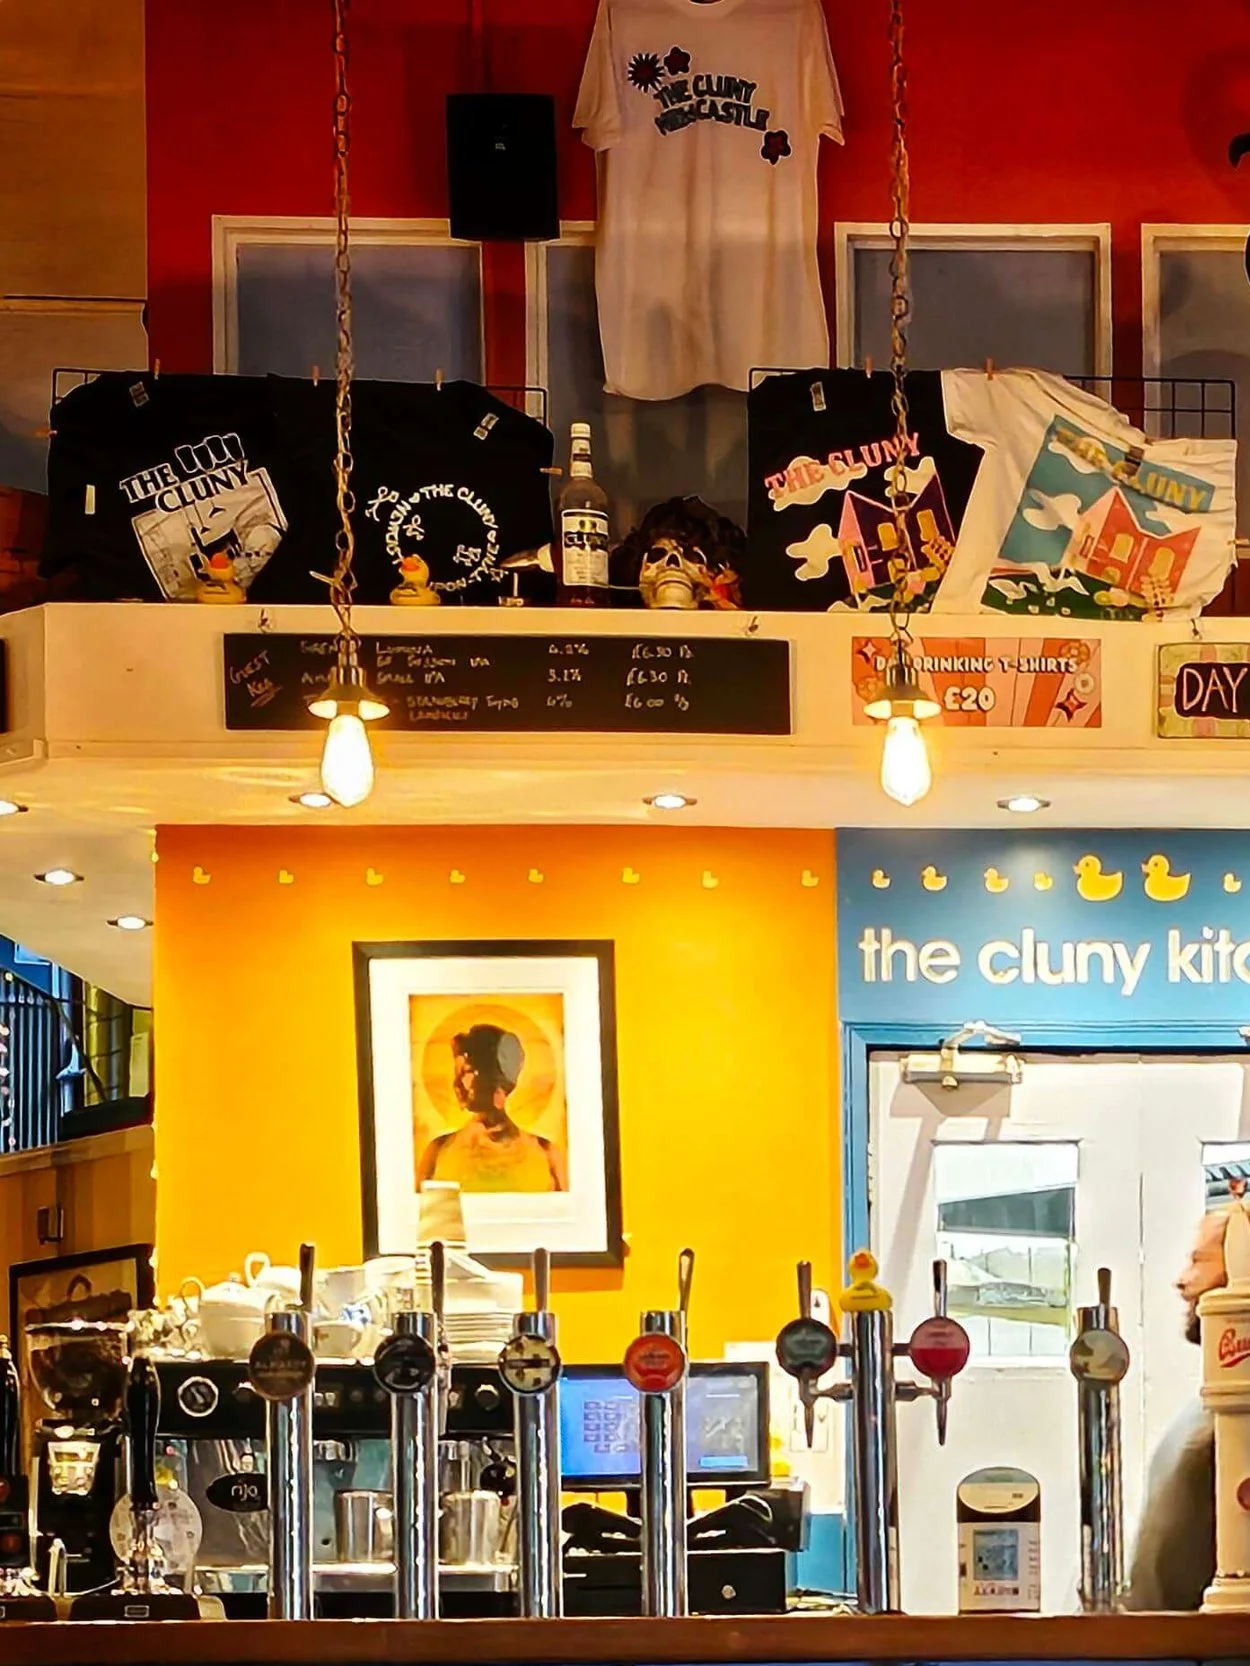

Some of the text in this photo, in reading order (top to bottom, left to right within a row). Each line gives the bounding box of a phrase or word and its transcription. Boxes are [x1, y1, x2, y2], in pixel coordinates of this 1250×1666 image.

[653, 79, 693, 109] THE
[119, 463, 179, 503] THE
[155, 460, 249, 515] CLUNY
[419, 483, 455, 500] THE
[764, 459, 825, 500] THE
[912, 655, 993, 674] DRINKING
[943, 686, 996, 712] £20
[1182, 666, 1248, 713] DAY
[858, 926, 961, 983] the
[978, 926, 1151, 996] cluny
